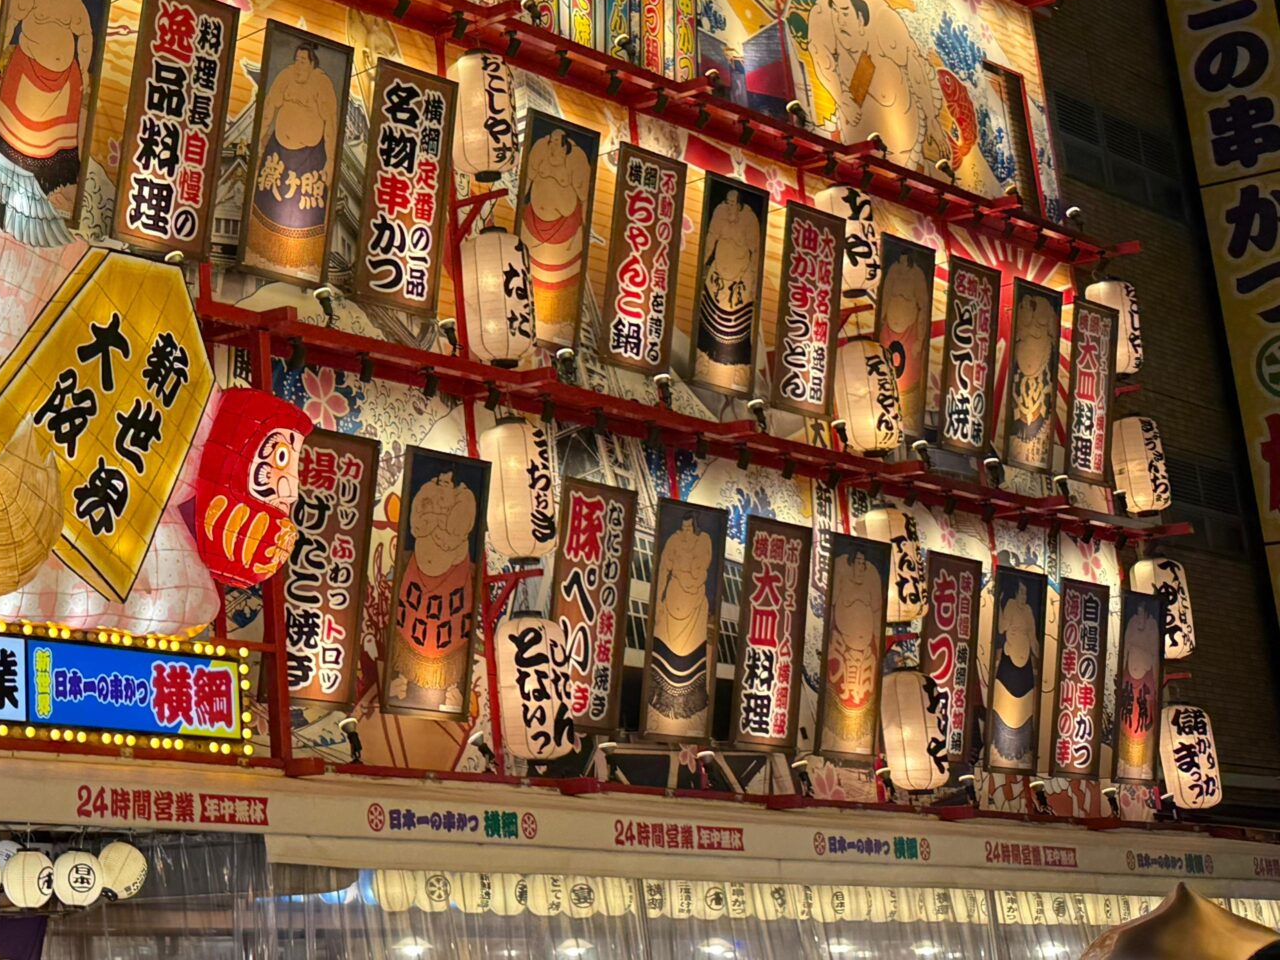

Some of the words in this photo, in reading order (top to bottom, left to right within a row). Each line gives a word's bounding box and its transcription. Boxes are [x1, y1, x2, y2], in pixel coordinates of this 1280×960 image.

[175, 15, 224, 240] 料理長自慢の
[368, 79, 423, 293] 名物串かつ
[405, 89, 446, 301] 横綱定番の一品
[611, 192, 656, 359] ちゃんこ鍋
[780, 216, 819, 401] 油かすうどん
[286, 444, 338, 690] 揚げたこ焼き
[327, 536, 356, 609] ふわっ
[337, 455, 364, 529] カリッ
[52, 668, 150, 707] 日本一の串かつ
[149, 660, 235, 730] 横綱
[319, 615, 348, 695] トロッ
[590, 498, 625, 722] なにわの鉄板焼き
[739, 561, 784, 738] 大皿料理
[1055, 588, 1082, 767] 海の幸山の幸
[1073, 591, 1102, 770] 自慢の串かつ
[76, 784, 197, 822] 24時間営業
[203, 796, 269, 825] 年中無休
[388, 808, 480, 833] 日本一の串かつ
[484, 810, 520, 838] 横綱
[613, 819, 695, 849] 24時間営業
